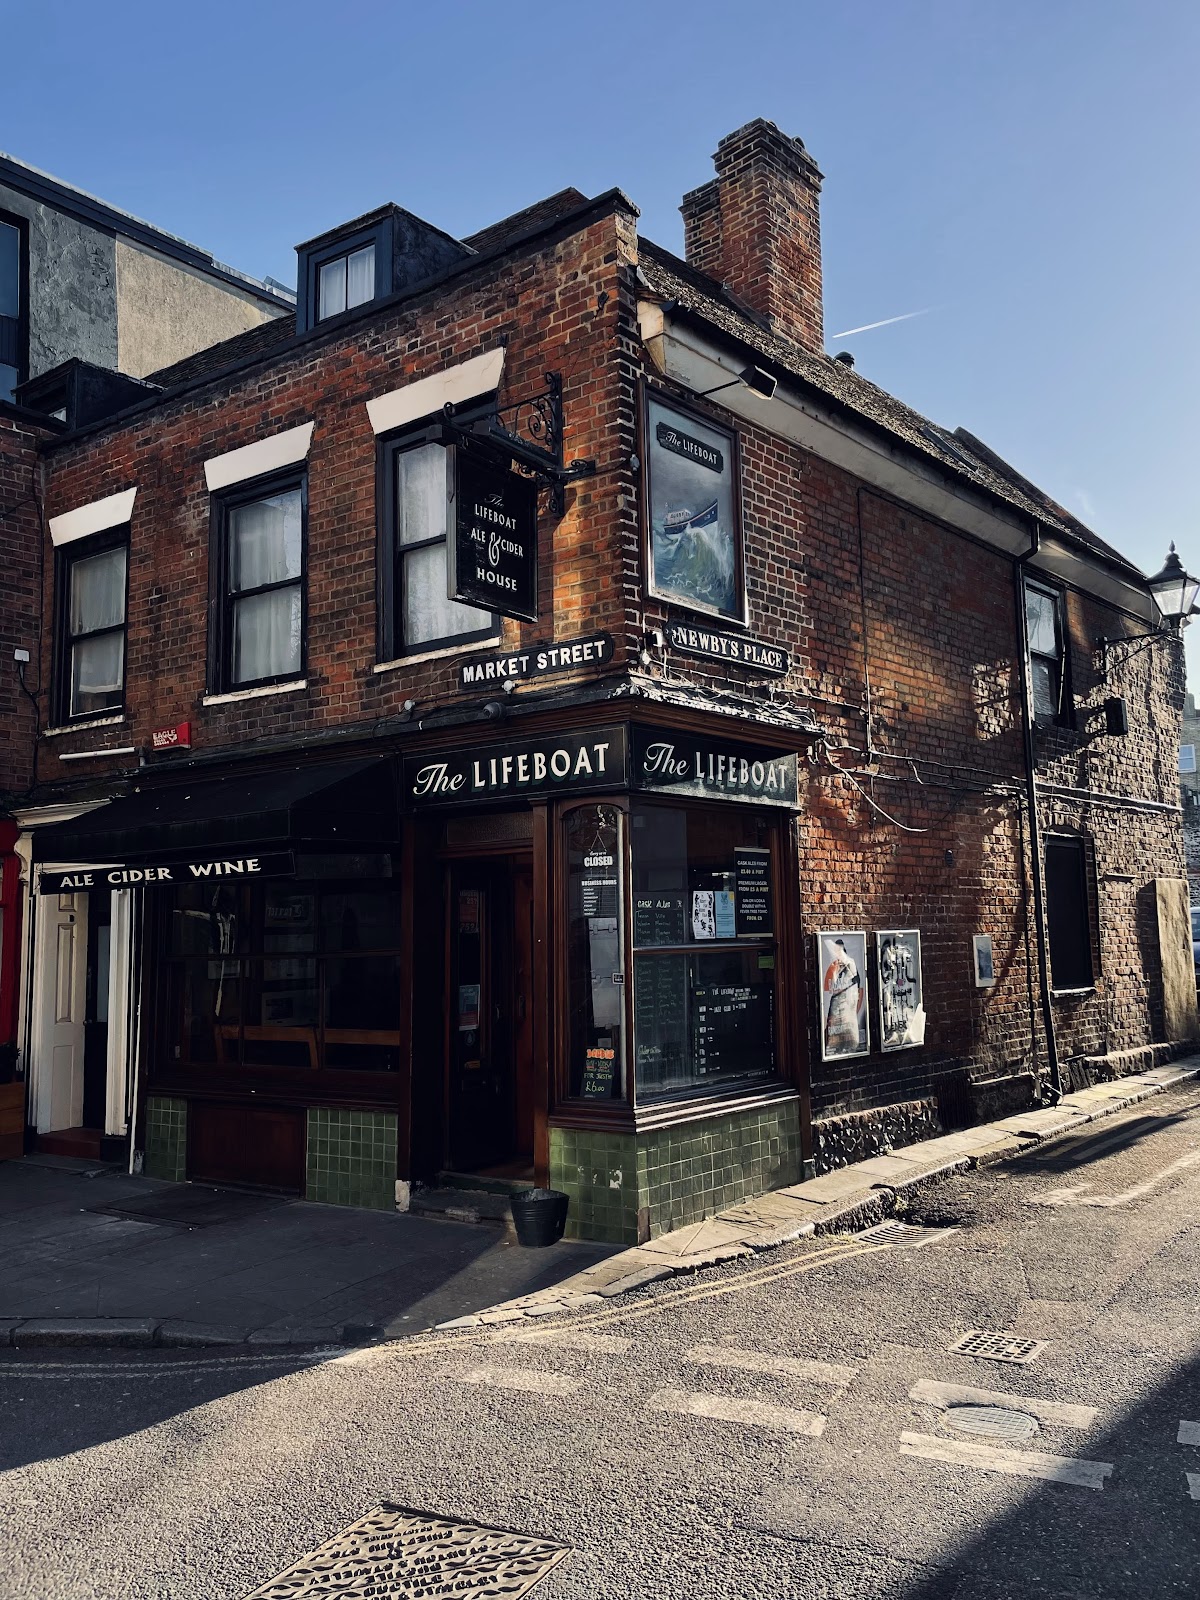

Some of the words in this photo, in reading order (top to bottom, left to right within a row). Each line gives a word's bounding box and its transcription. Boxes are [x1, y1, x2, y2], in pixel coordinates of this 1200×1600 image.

[665, 431, 682, 447] The
[683, 439, 717, 465] LIFEBOAT
[475, 503, 517, 530] LIFEBOAT
[471, 527, 486, 543] ALE
[488, 531, 502, 566] &
[501, 539, 523, 557] CIDER
[476, 566, 517, 591] HOUSE
[462, 655, 530, 683] MARKET
[536, 640, 606, 670] STREET
[677, 626, 740, 657] NEWBY'S
[743, 643, 783, 668] PLACE
[152, 729, 176, 740] EAGLE
[412, 763, 467, 795] The
[472, 742, 610, 788] LIFEBOAT
[643, 743, 690, 776] The
[694, 751, 788, 790] LIFEBOAT
[60, 874, 95, 888] ALE
[107, 867, 174, 884] CIDER
[189, 858, 262, 877] WINE
[583, 855, 613, 868] CLOSED
